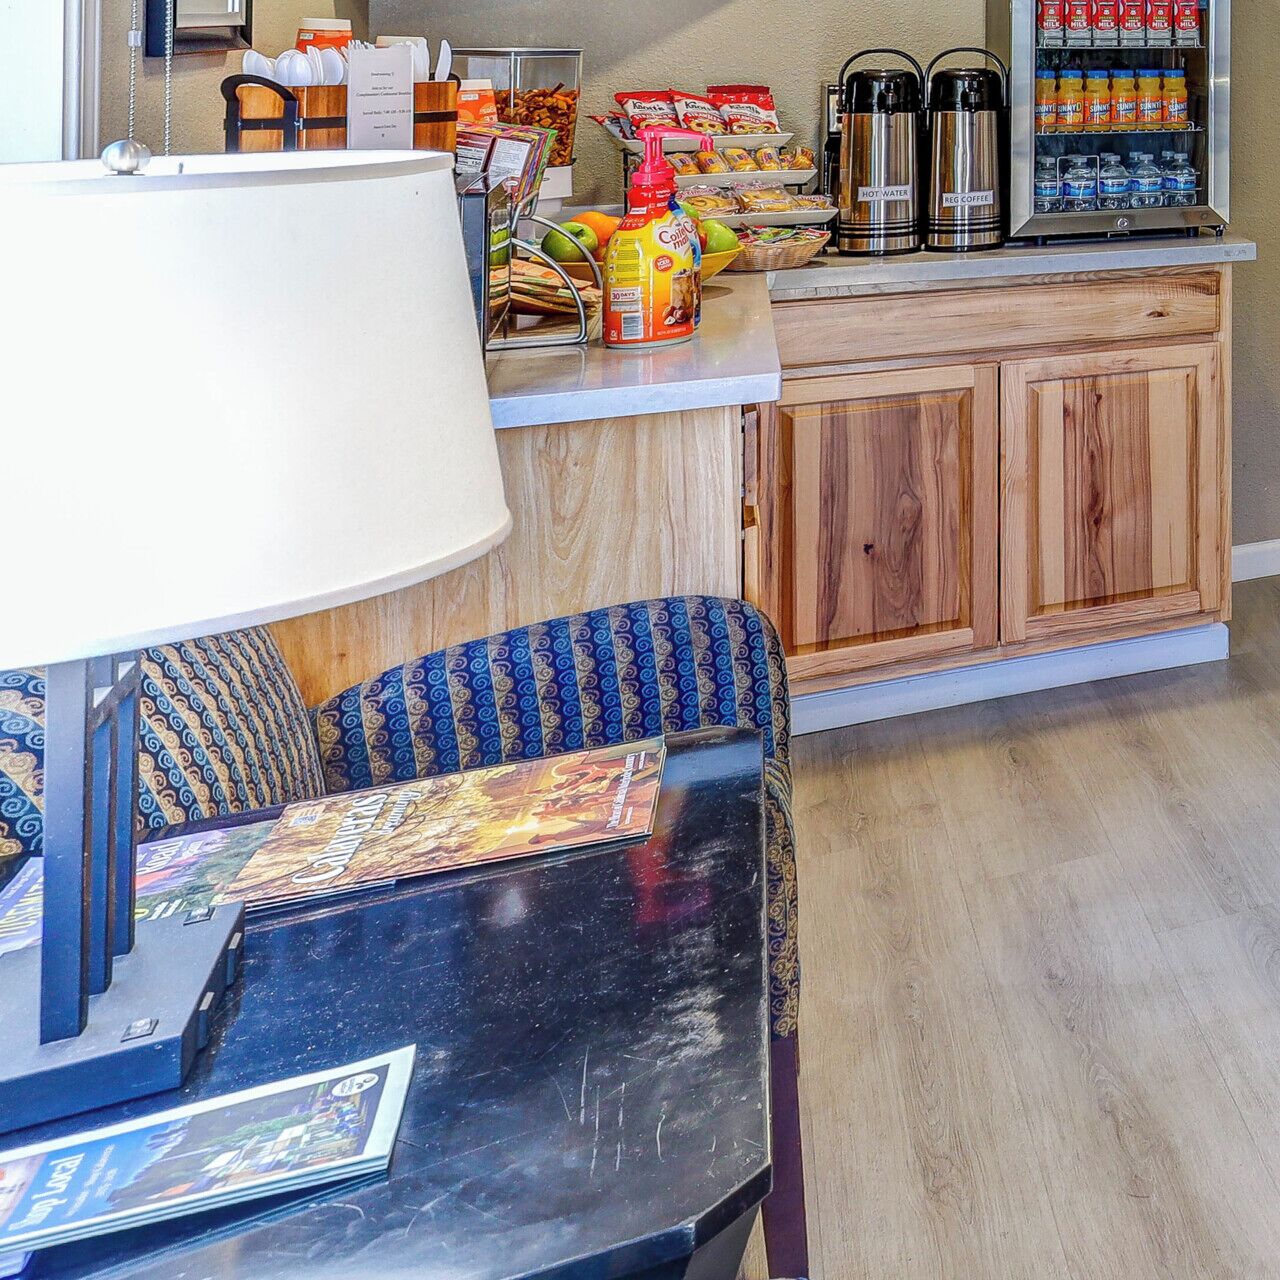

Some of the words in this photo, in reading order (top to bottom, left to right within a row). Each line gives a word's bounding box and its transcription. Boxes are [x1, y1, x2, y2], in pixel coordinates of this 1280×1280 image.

[862, 190, 879, 198] HOT
[881, 189, 908, 197] WATER
[961, 195, 989, 203] COFFEE
[612, 292, 621, 301] 30
[371, 791, 421, 835] dreaming
[292, 792, 388, 883] Calaveras
[31, 1153, 85, 1200] Local
